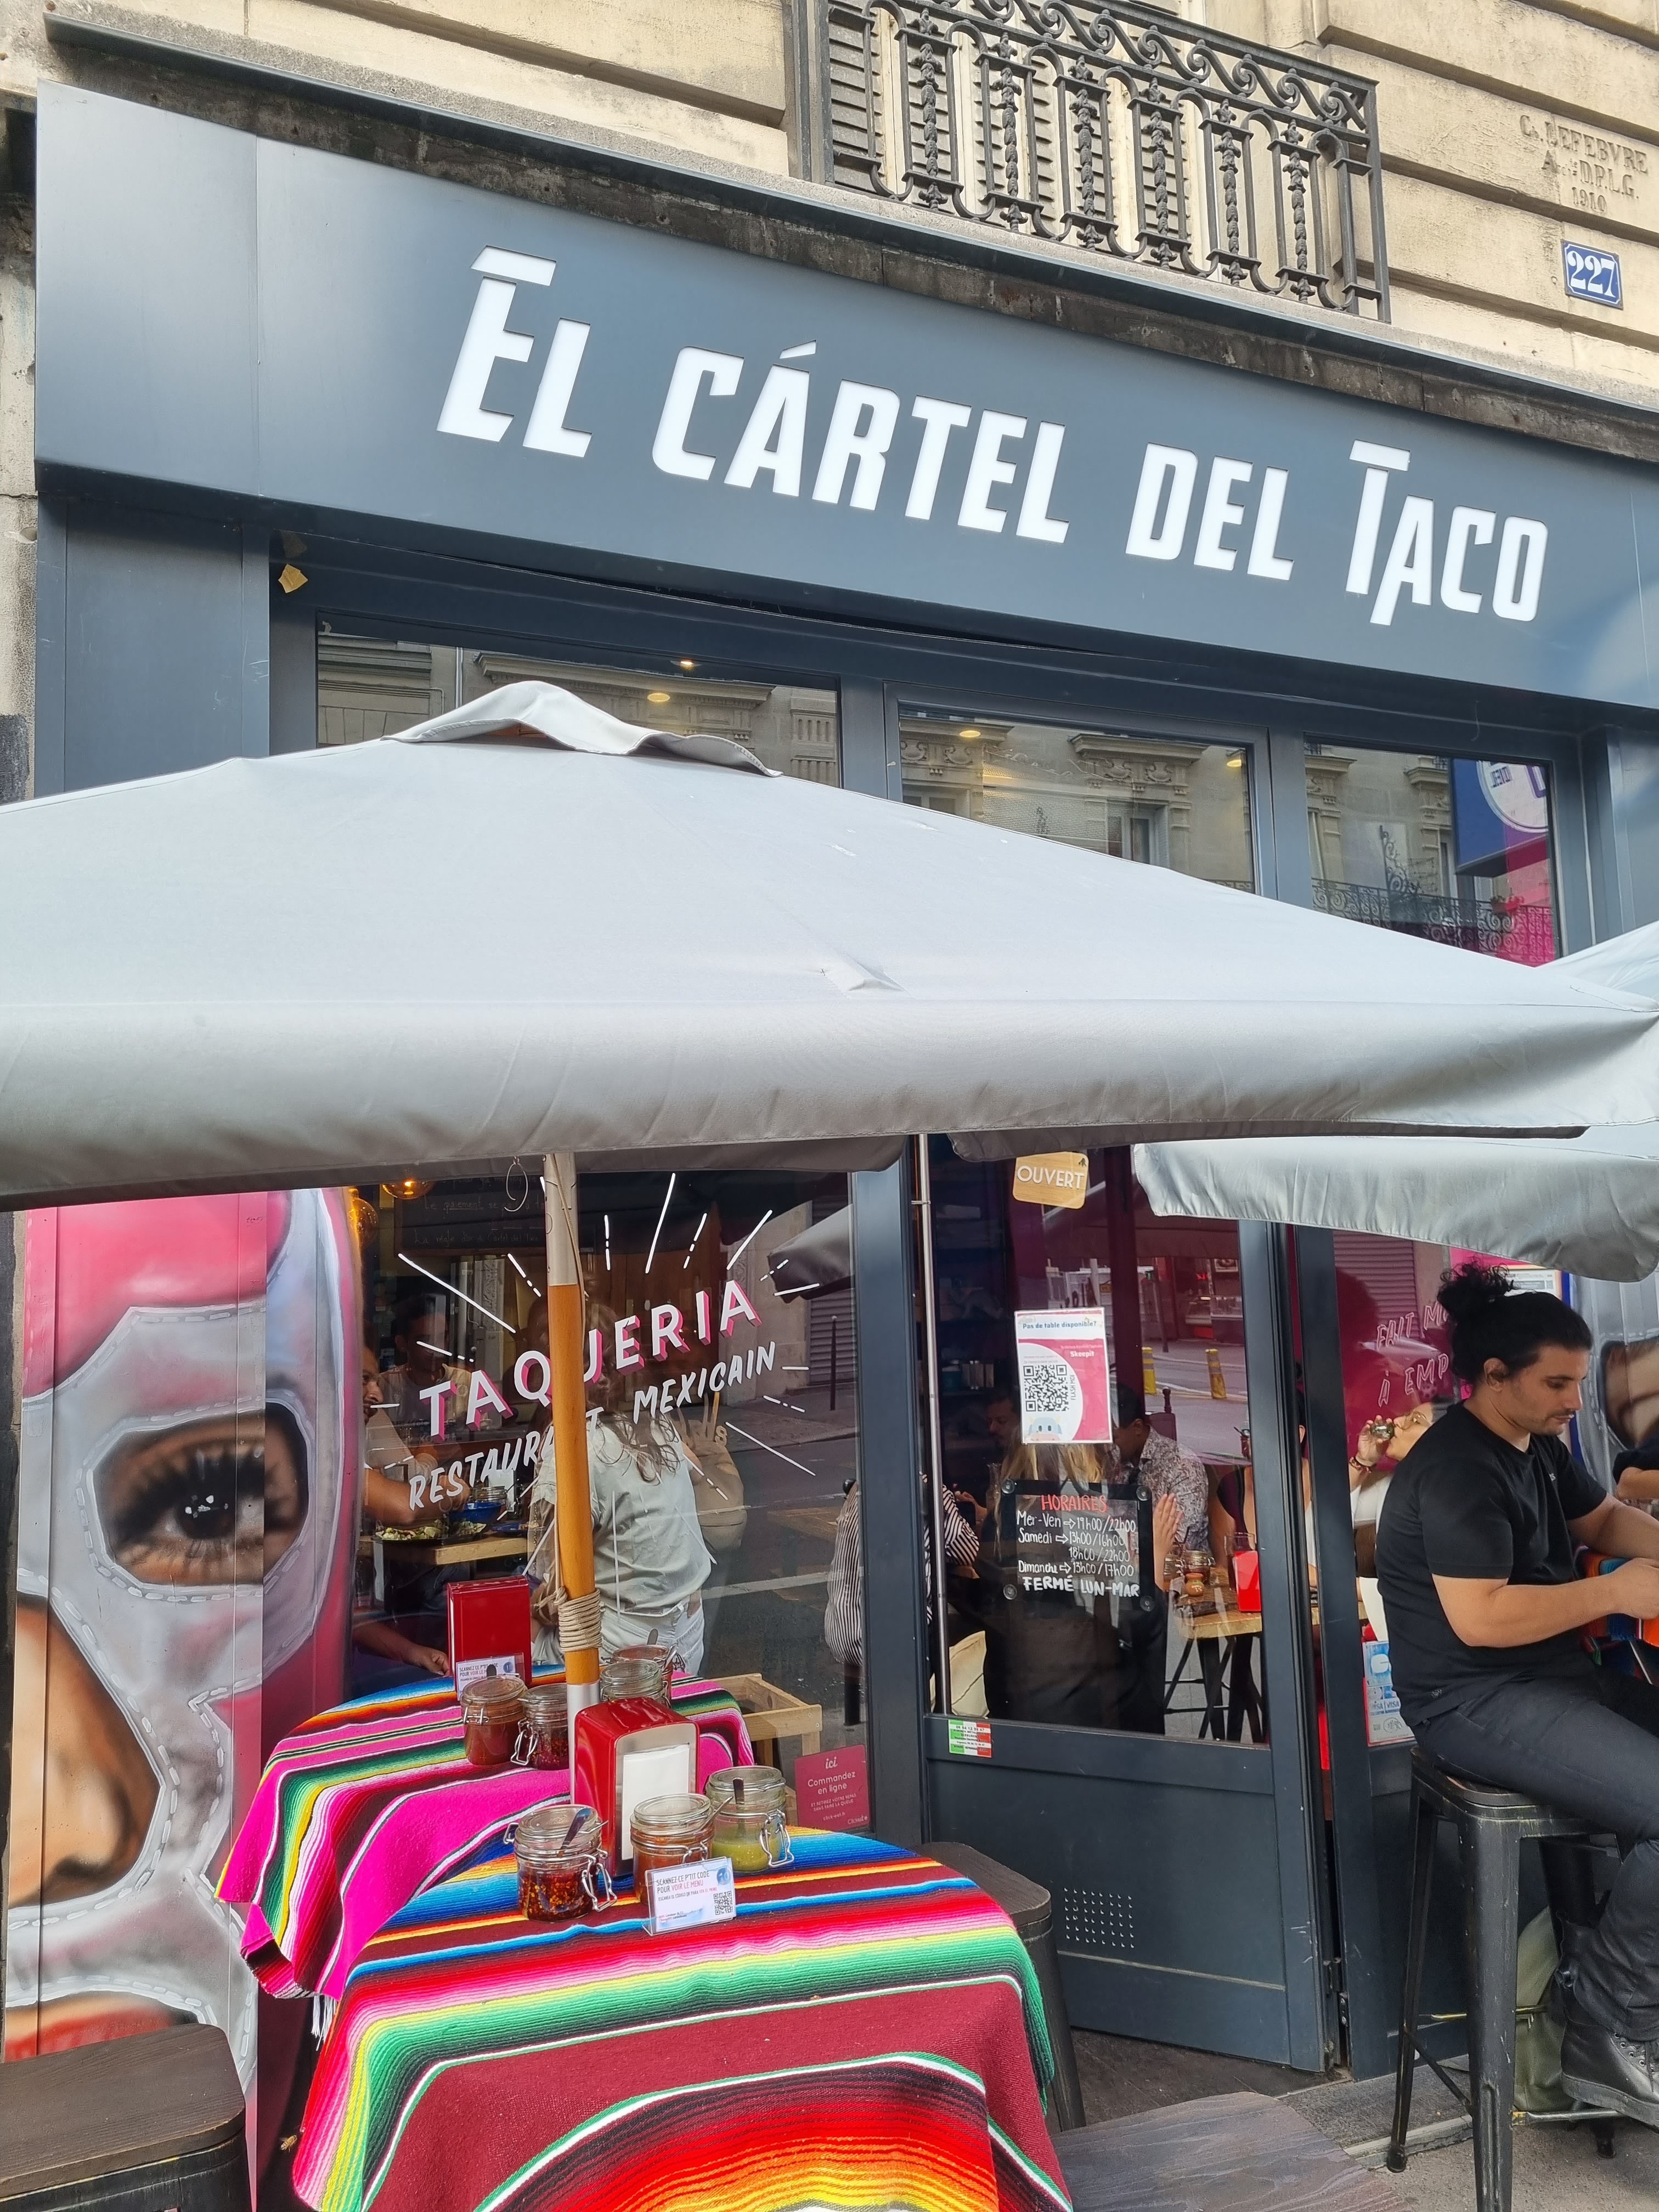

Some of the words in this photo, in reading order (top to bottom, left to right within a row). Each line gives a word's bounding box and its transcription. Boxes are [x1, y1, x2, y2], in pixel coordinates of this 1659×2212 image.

[1571, 187, 1607, 212] 1910
[1567, 250, 1616, 298] 227
[437, 245, 593, 458] EL
[652, 339, 1070, 544] CÁRTEL
[1125, 442, 1295, 581] DEL
[1346, 439, 1549, 626] TACO
[1017, 1165, 1085, 1190] OUVERT
[1061, 1321, 1097, 1329] disponible?
[1376, 1312, 1414, 1351] FAIT
[1424, 1301, 1449, 1330] M
[1070, 1350, 1094, 1358] Skeepit
[409, 1406, 604, 1511] RESTAURAT
[633, 1341, 776, 1425] MEXICAIN
[1040, 1494, 1108, 1513] HORAIRES
[1017, 1510, 1062, 1528] Mer-Ven
[1018, 1527, 1052, 1544] Samedi
[1018, 1560, 1059, 1575] Dimanche
[1023, 1575, 1075, 1592] FERMÉ
[1080, 1583, 1140, 1598] LUN-MAR
[825, 1756, 838, 1769] ici
[808, 1770, 856, 1787] Commandez
[817, 1787, 827, 1795] en
[829, 1782, 848, 1793] ligne
[656, 1877, 677, 1886] SCANNEZ
[697, 1870, 710, 1878] CODE
[657, 1885, 670, 1894] POUR
[672, 1883, 683, 1891] VOIR
[690, 1880, 704, 1888] MENU
